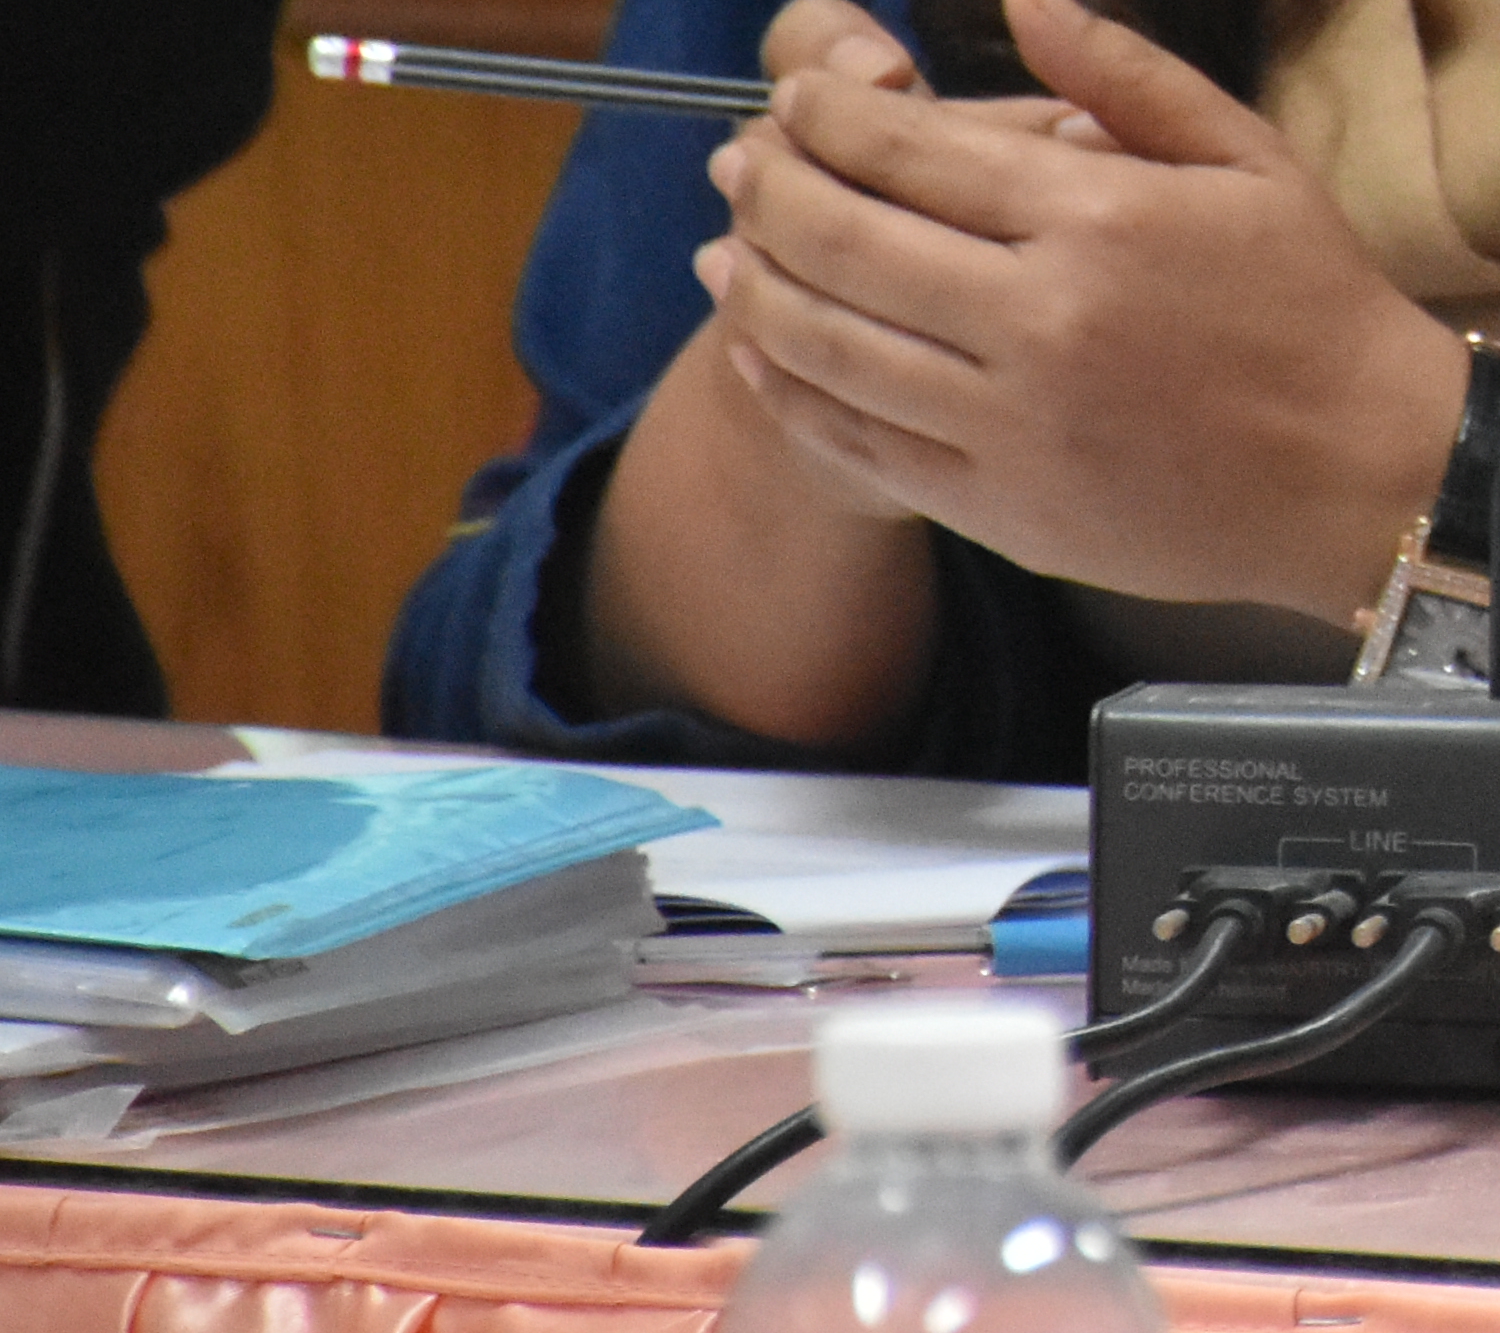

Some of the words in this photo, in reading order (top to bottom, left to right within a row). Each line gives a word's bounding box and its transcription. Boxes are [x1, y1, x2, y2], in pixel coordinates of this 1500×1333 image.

[1124, 756, 1302, 780] PROFESSIONAL
[1124, 781, 1284, 805] CONFERENCE
[1293, 786, 1389, 807] SYSTEM
[1350, 831, 1407, 853] LINE
